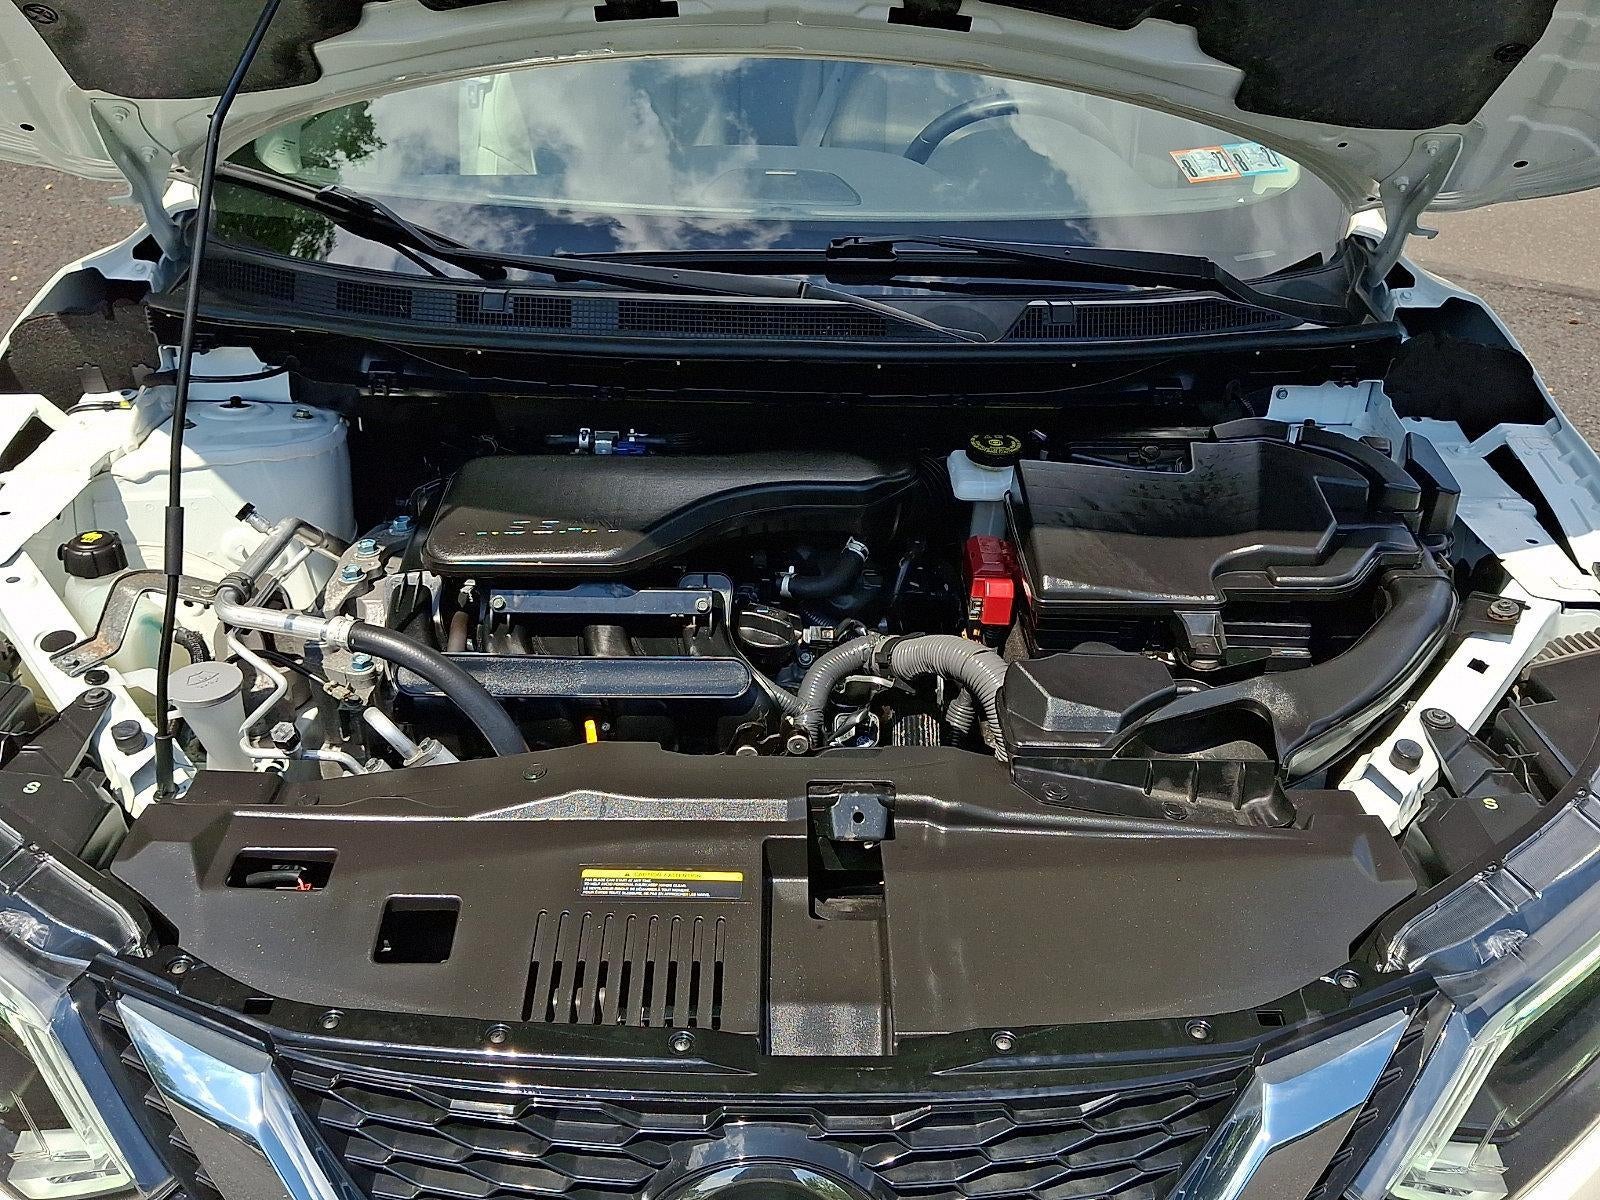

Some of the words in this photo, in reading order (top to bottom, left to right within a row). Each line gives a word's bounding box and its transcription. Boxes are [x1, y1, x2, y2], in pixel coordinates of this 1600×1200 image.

[1181, 159, 1198, 178] 8
[1232, 153, 1249, 171] 8
[22, 781, 42, 794] S
[1482, 797, 1499, 810] S
